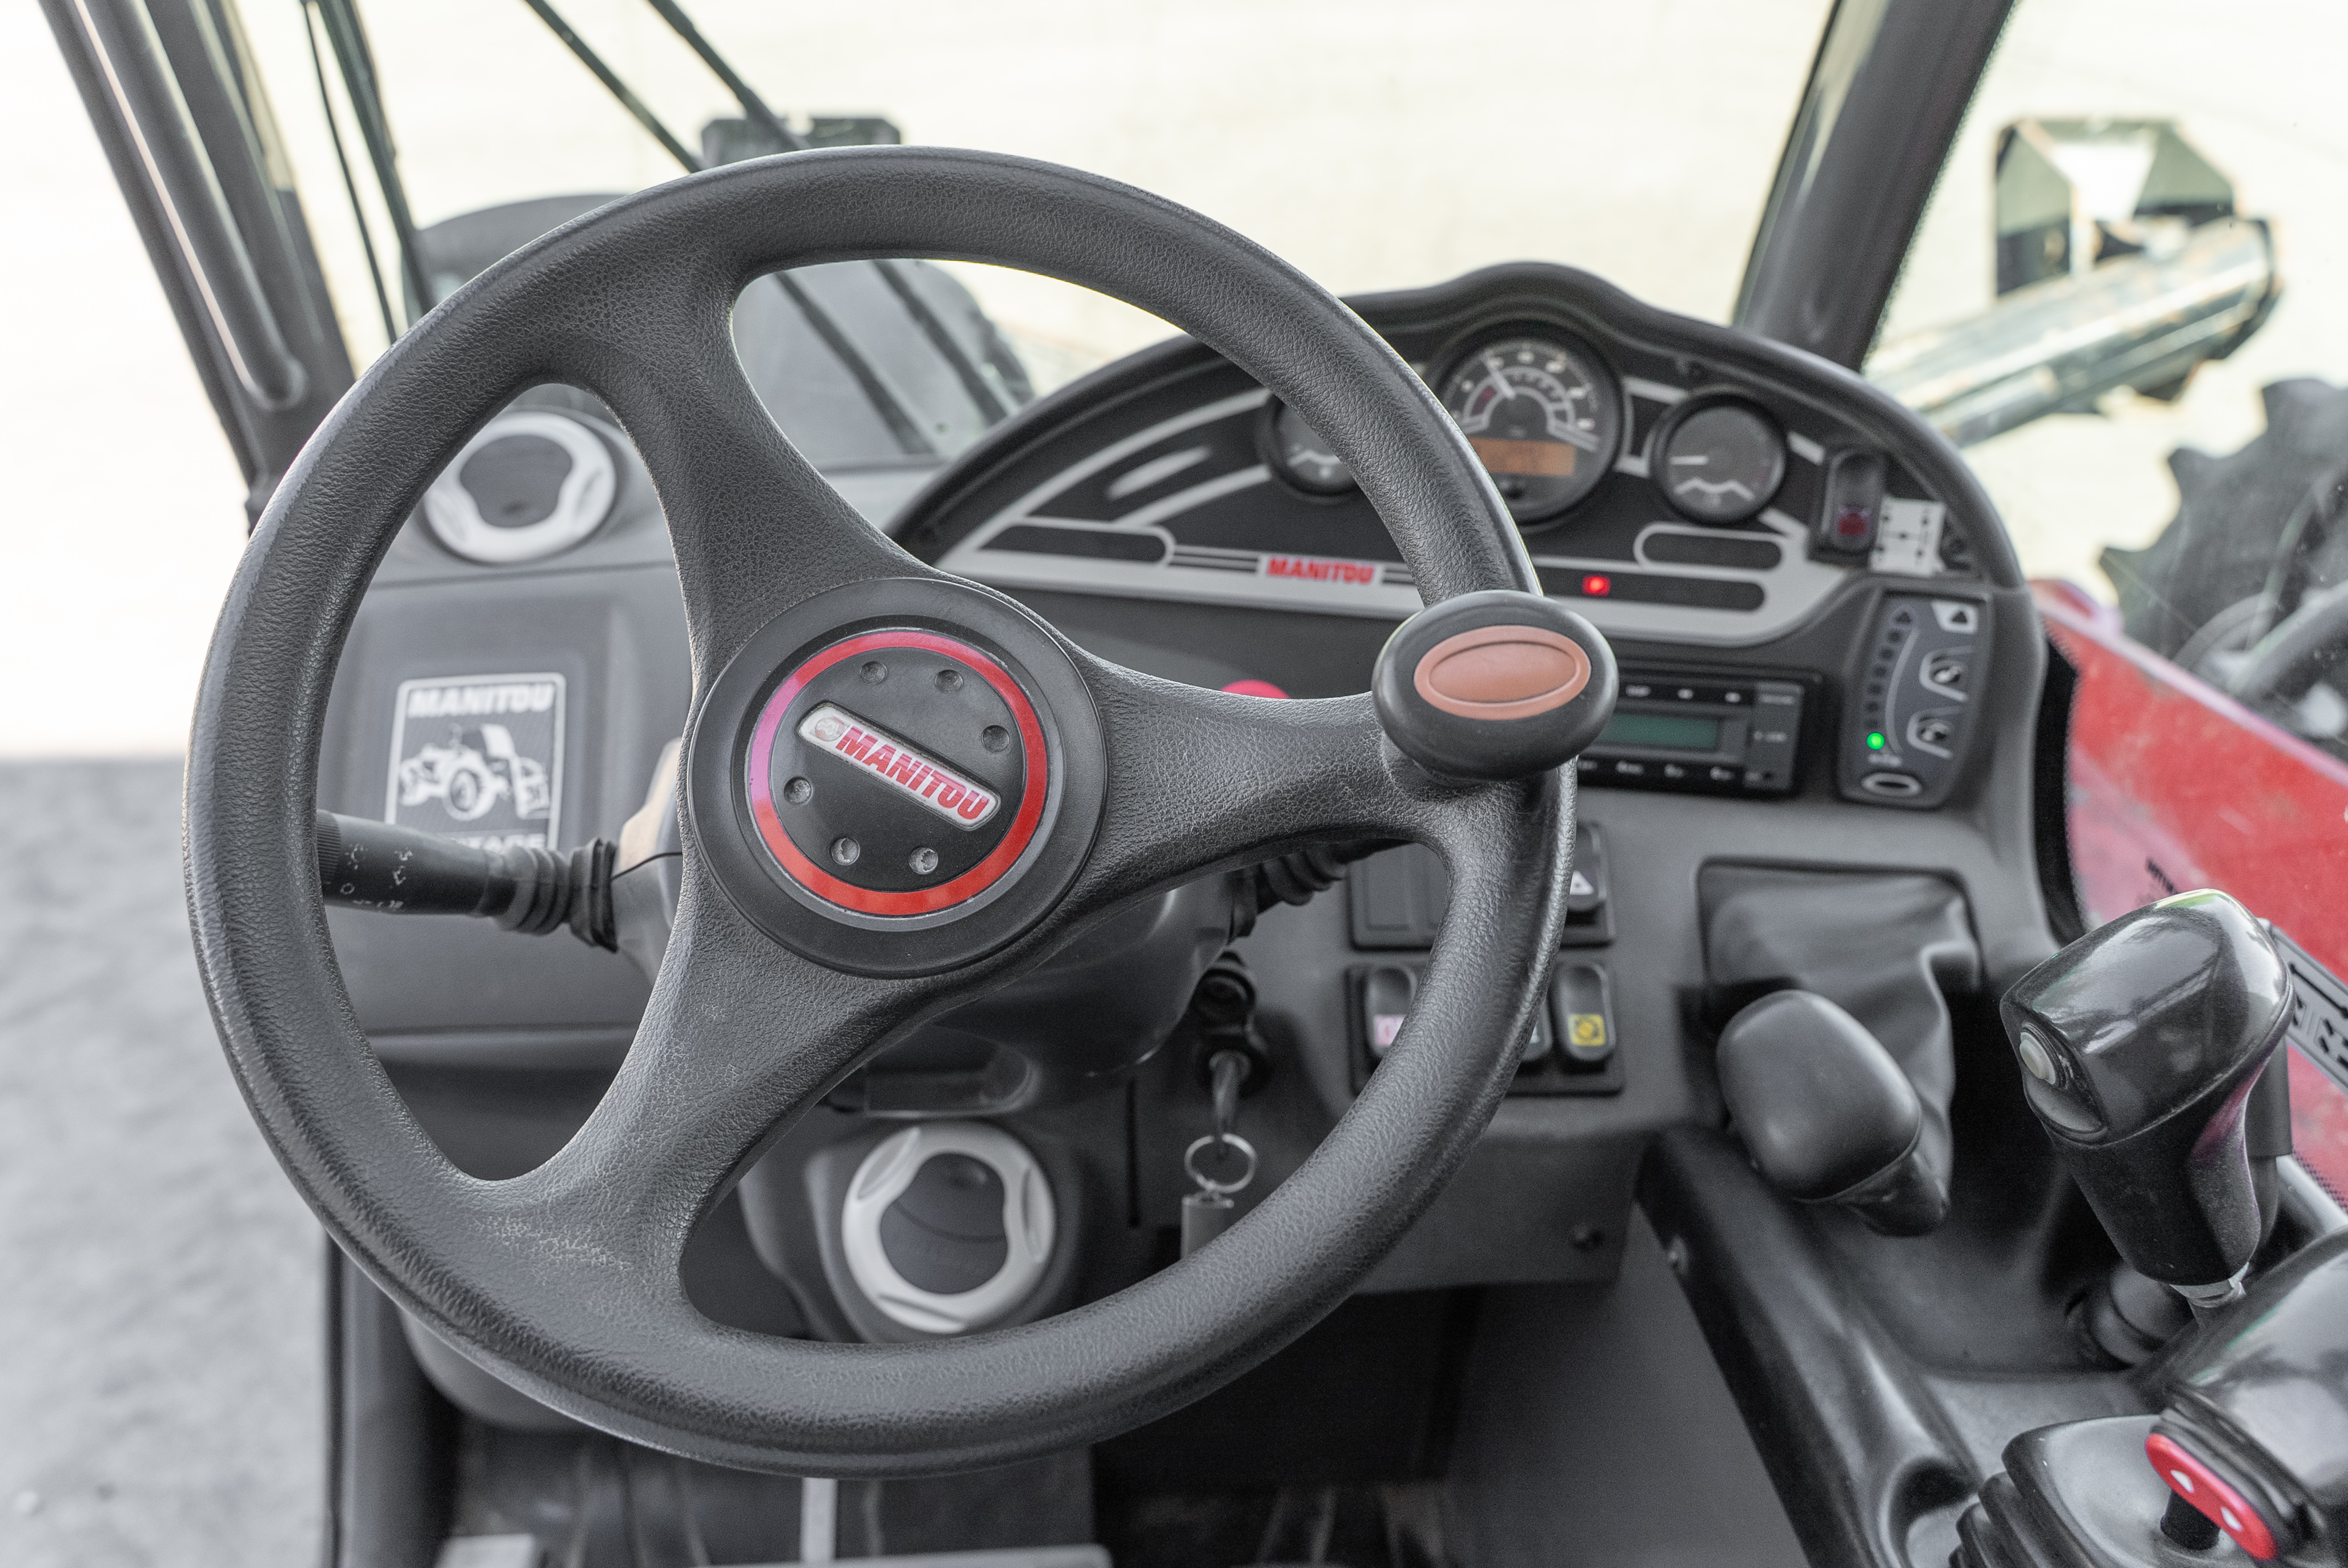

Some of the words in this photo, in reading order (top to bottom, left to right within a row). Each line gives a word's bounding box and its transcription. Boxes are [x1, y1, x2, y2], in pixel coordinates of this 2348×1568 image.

[1266, 556, 1375, 585] MANITOU
[407, 685, 554, 718] MANITOU
[835, 726, 990, 819] MANITOU
